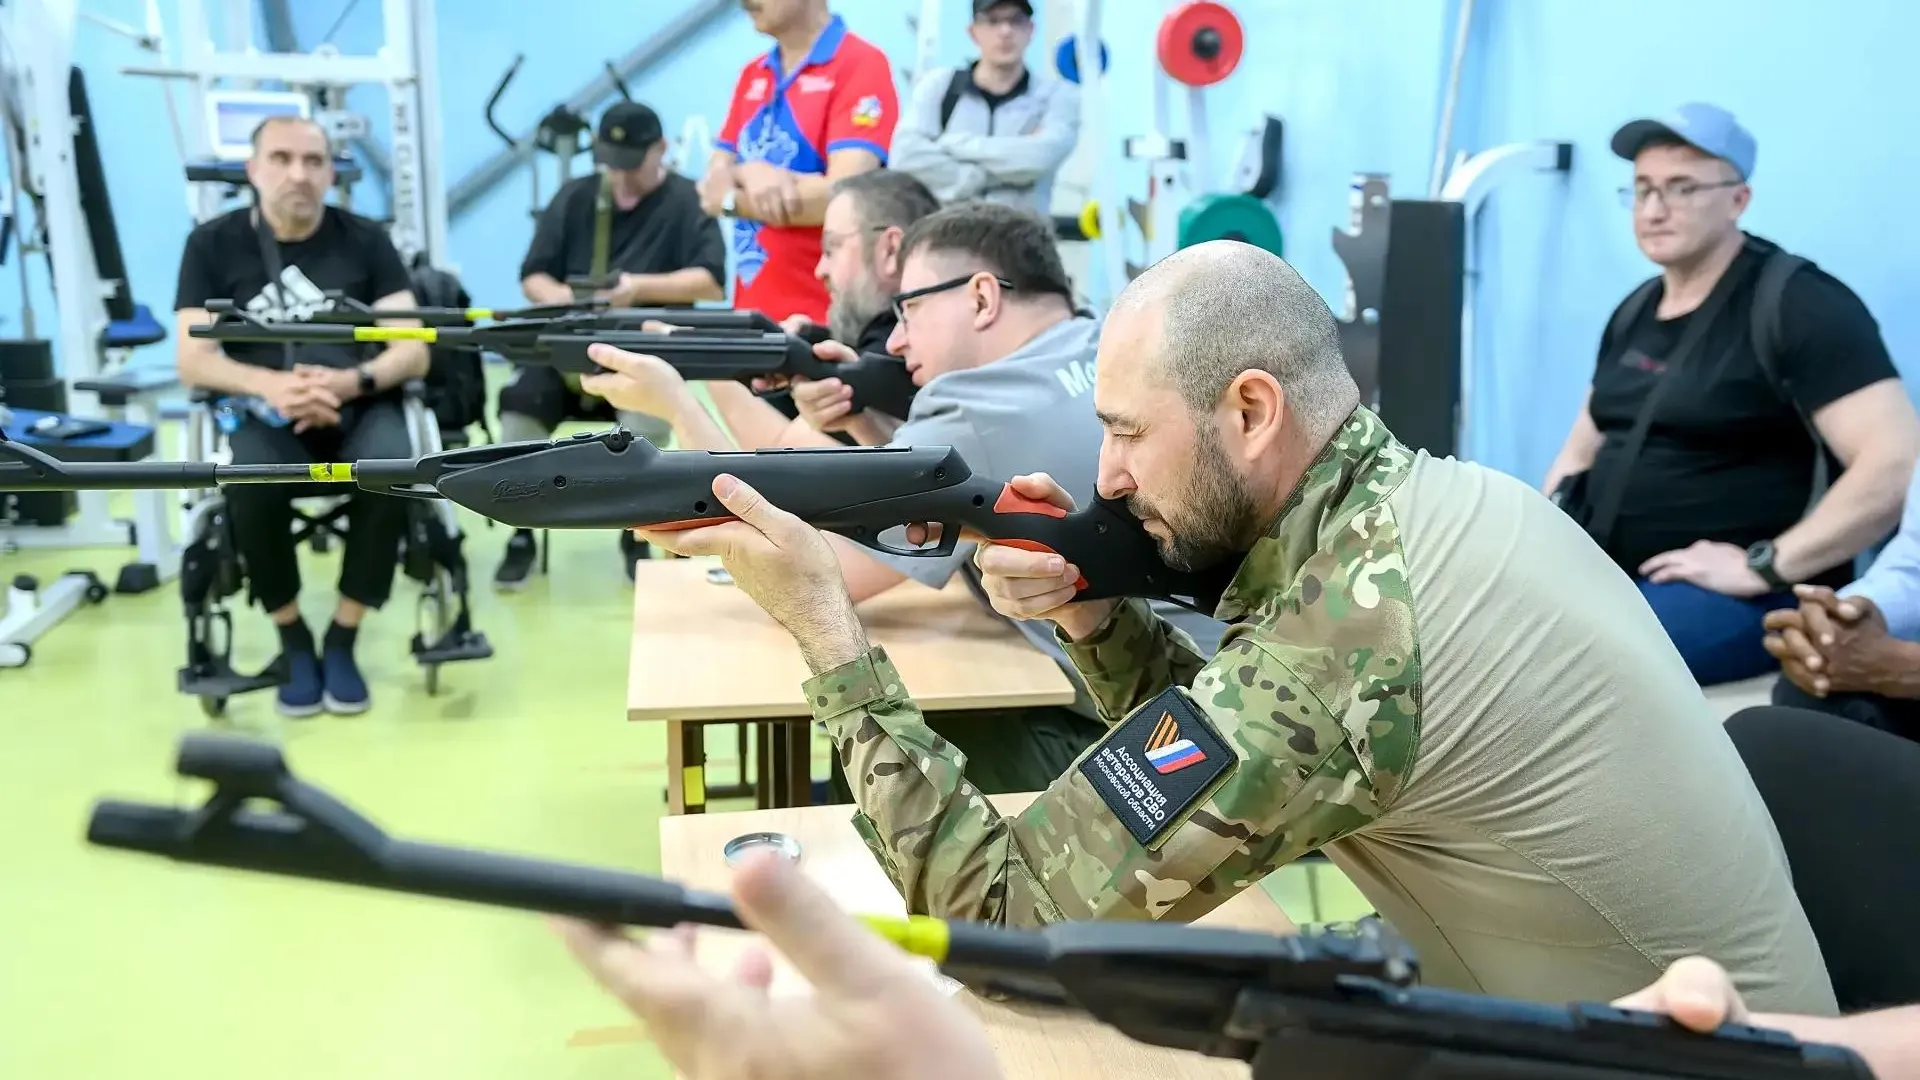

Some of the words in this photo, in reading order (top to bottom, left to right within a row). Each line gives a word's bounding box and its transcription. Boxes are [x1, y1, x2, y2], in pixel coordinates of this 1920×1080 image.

[1094, 755, 1130, 800] Московской
[1127, 798, 1156, 831] области
[1101, 747, 1145, 799] ветеранов
[1143, 797, 1165, 821] СВО
[1116, 746, 1167, 807] Ассоциация
